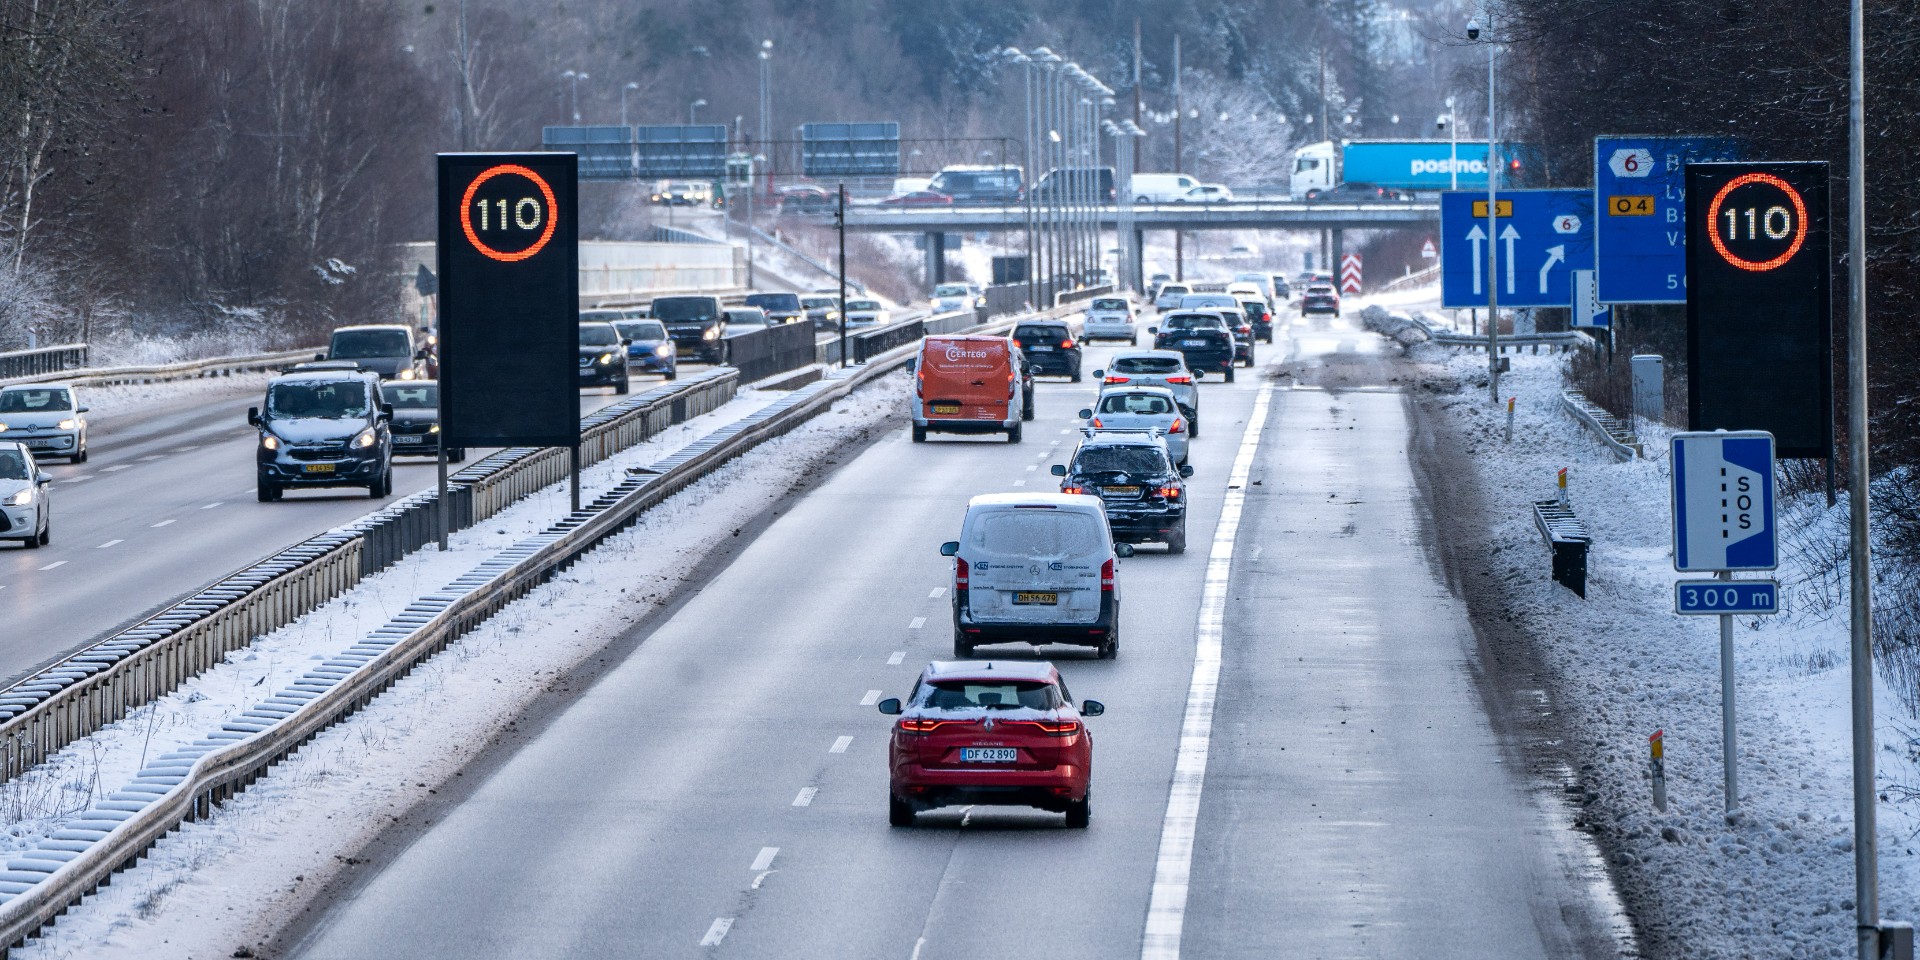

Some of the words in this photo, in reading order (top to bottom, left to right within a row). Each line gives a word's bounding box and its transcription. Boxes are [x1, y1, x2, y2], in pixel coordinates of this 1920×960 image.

[1410, 158, 1504, 176] postno
[1625, 154, 1638, 172] 6
[477, 197, 541, 231] 110
[1562, 218, 1571, 231] 6
[1725, 206, 1791, 240] 110
[1666, 274, 1687, 290] 5
[950, 350, 987, 359] CERTEGO
[1737, 476, 1752, 530] SOS
[974, 562, 988, 570] KEN
[1048, 562, 1062, 571] KEN
[1686, 588, 1739, 607] 300
[1752, 592, 1769, 606] m
[967, 749, 981, 759] DF
[983, 749, 995, 759] 62
[997, 749, 1016, 759] 890
